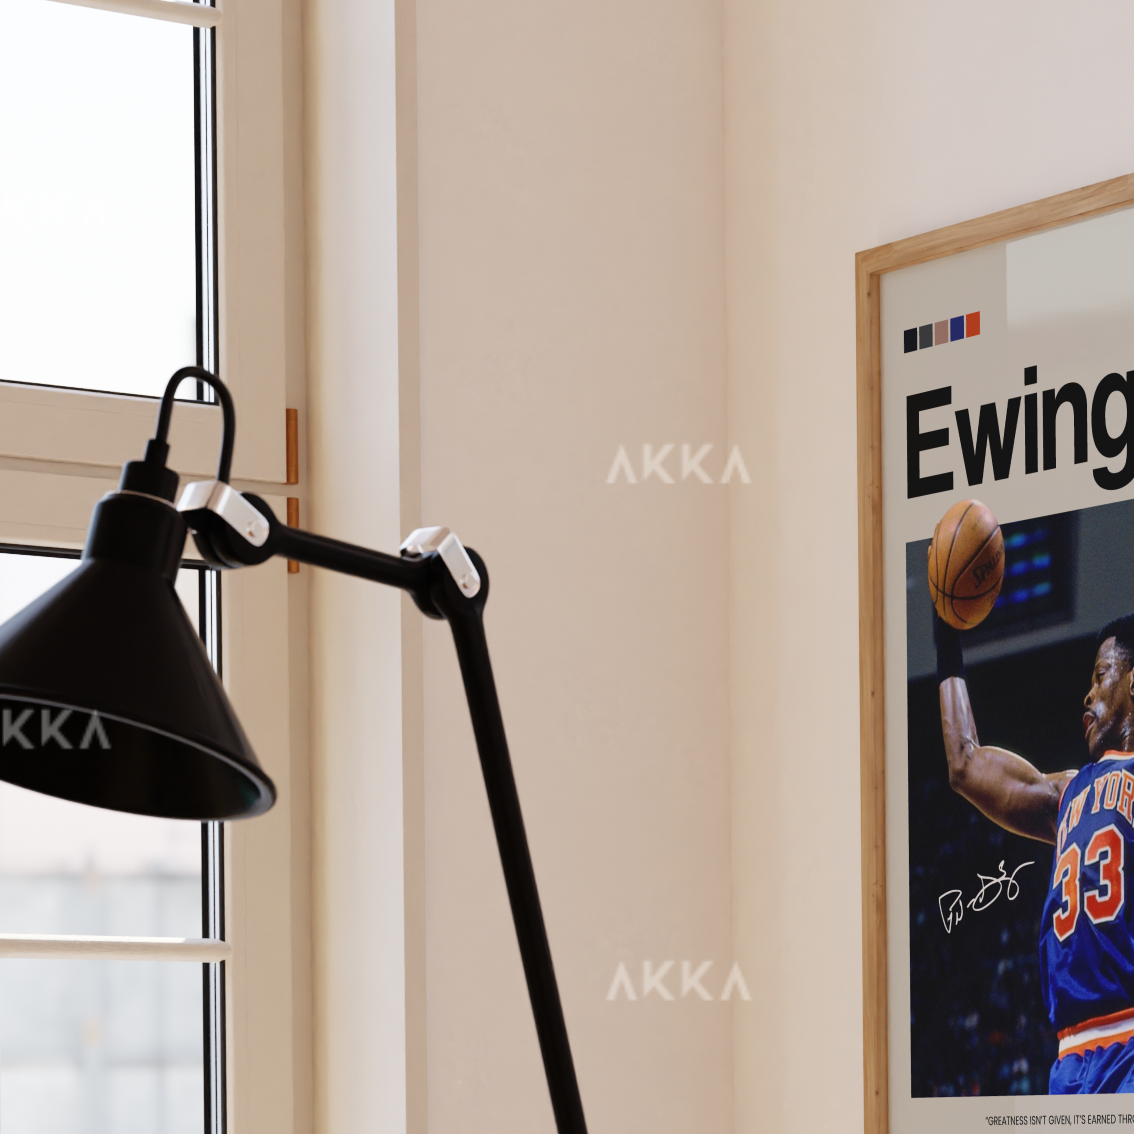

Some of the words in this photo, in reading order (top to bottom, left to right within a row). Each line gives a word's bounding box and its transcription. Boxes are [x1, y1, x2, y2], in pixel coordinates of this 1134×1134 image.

[1053, 824, 1124, 942] 33
[1029, 1116, 1047, 1125] ISN'T
[1048, 1115, 1072, 1126] GIVEN,
[1073, 1114, 1086, 1124] IT'S
[1088, 1114, 1116, 1124] EARNED
